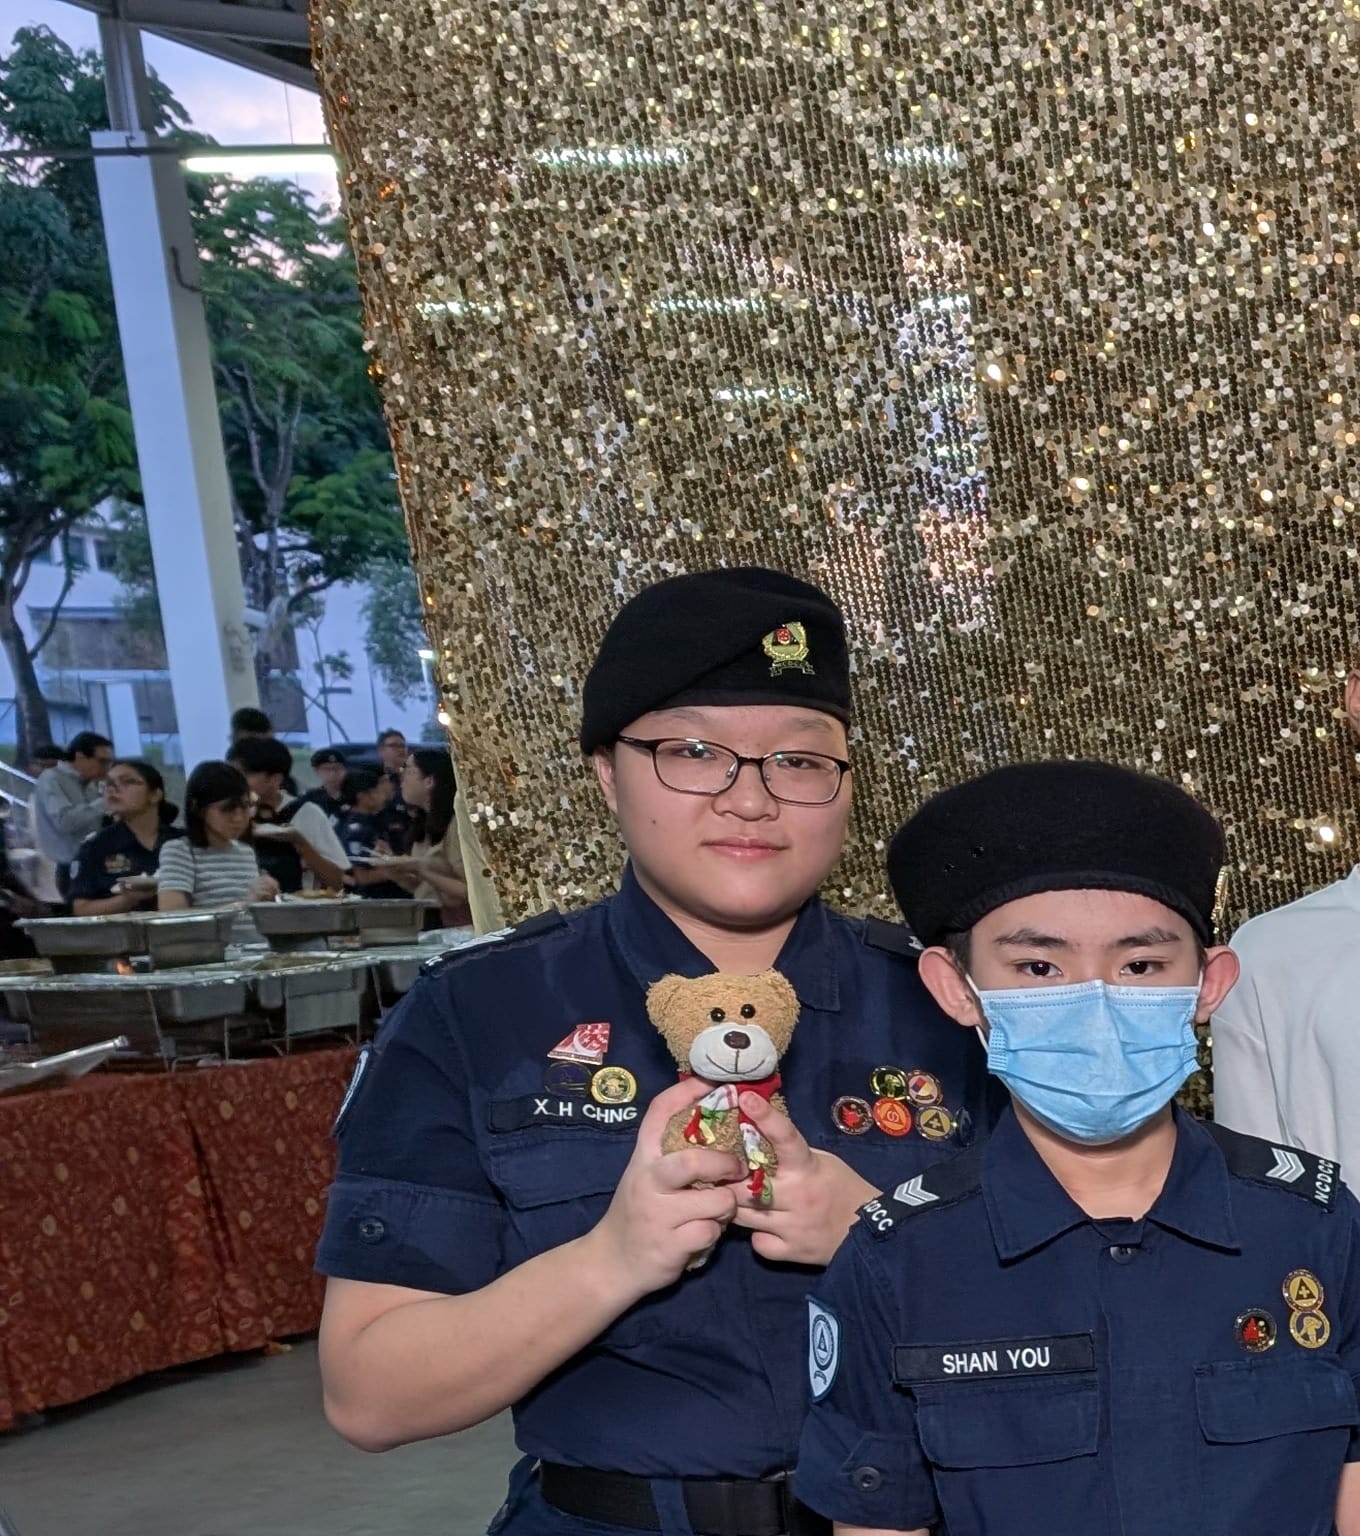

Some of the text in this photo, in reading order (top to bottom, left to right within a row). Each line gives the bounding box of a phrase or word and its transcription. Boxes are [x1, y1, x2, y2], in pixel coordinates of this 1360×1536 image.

[532, 1098, 638, 1124] X H CHNG
[942, 1346, 1050, 1374] SHAN YOU
